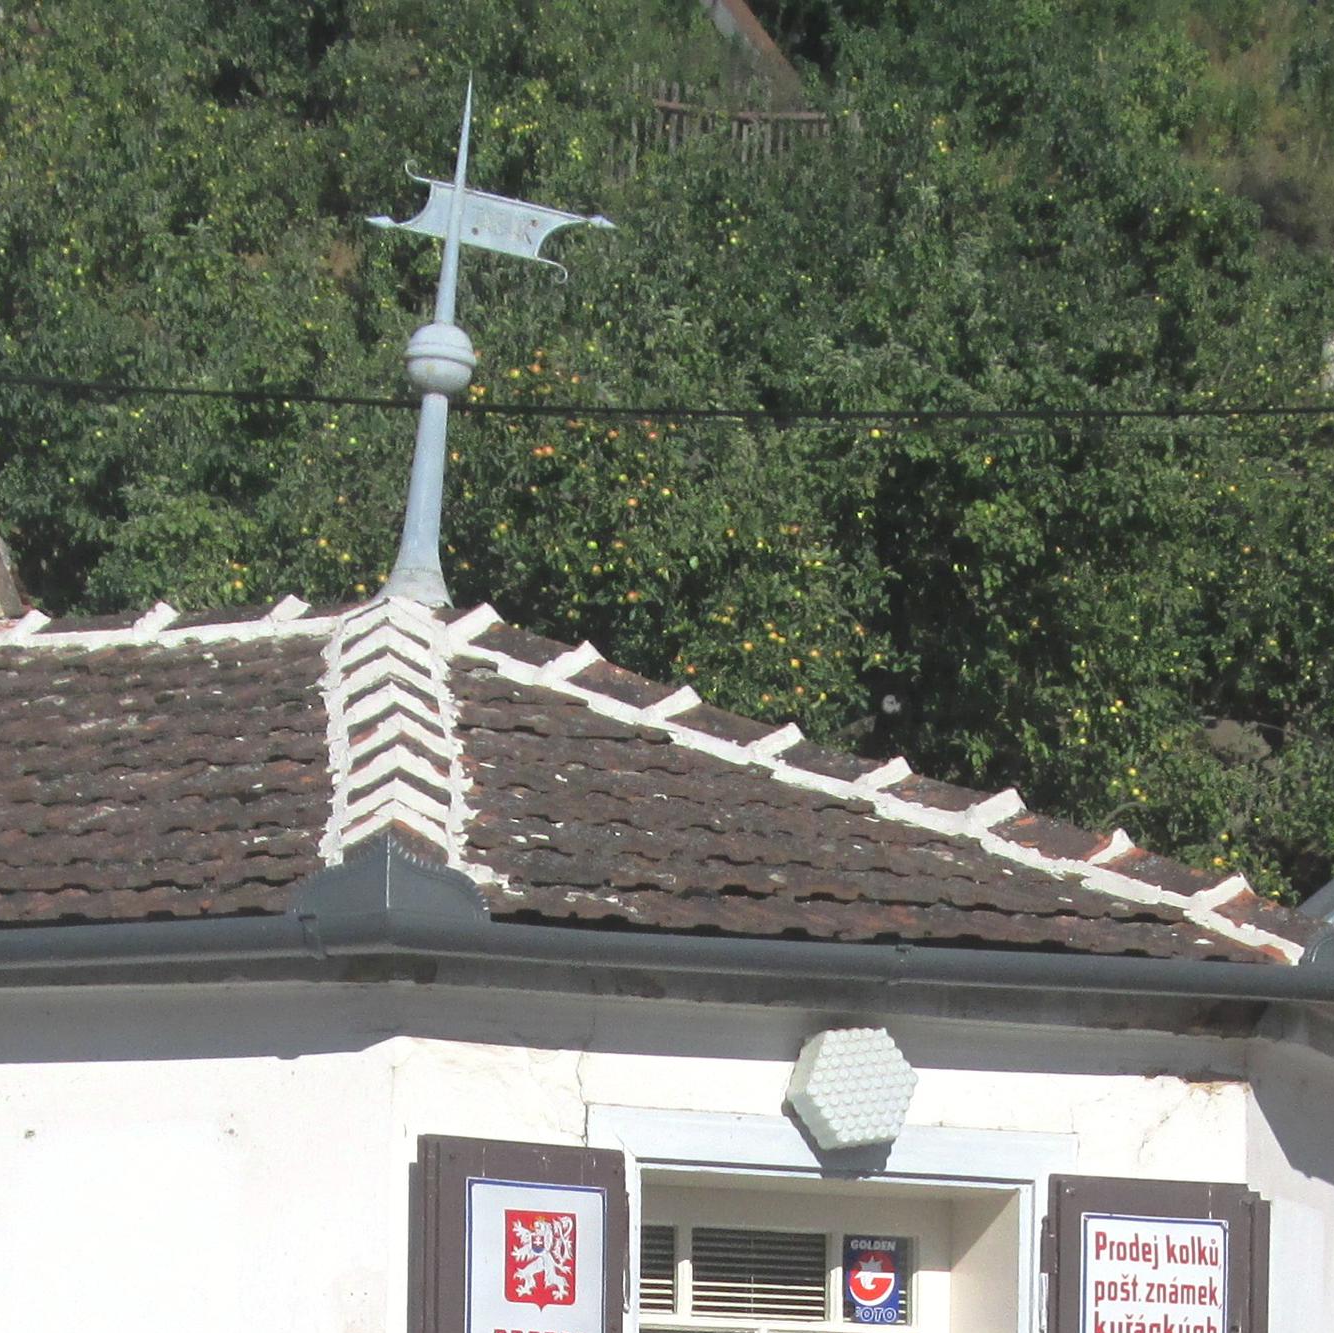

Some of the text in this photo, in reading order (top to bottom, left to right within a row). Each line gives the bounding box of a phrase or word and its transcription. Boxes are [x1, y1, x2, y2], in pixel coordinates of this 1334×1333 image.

[850, 1239, 897, 1252] GOLDEN
[1095, 1231, 1222, 1270] Prodej kolků,
[1094, 1273, 1223, 1310] pošt. známek,
